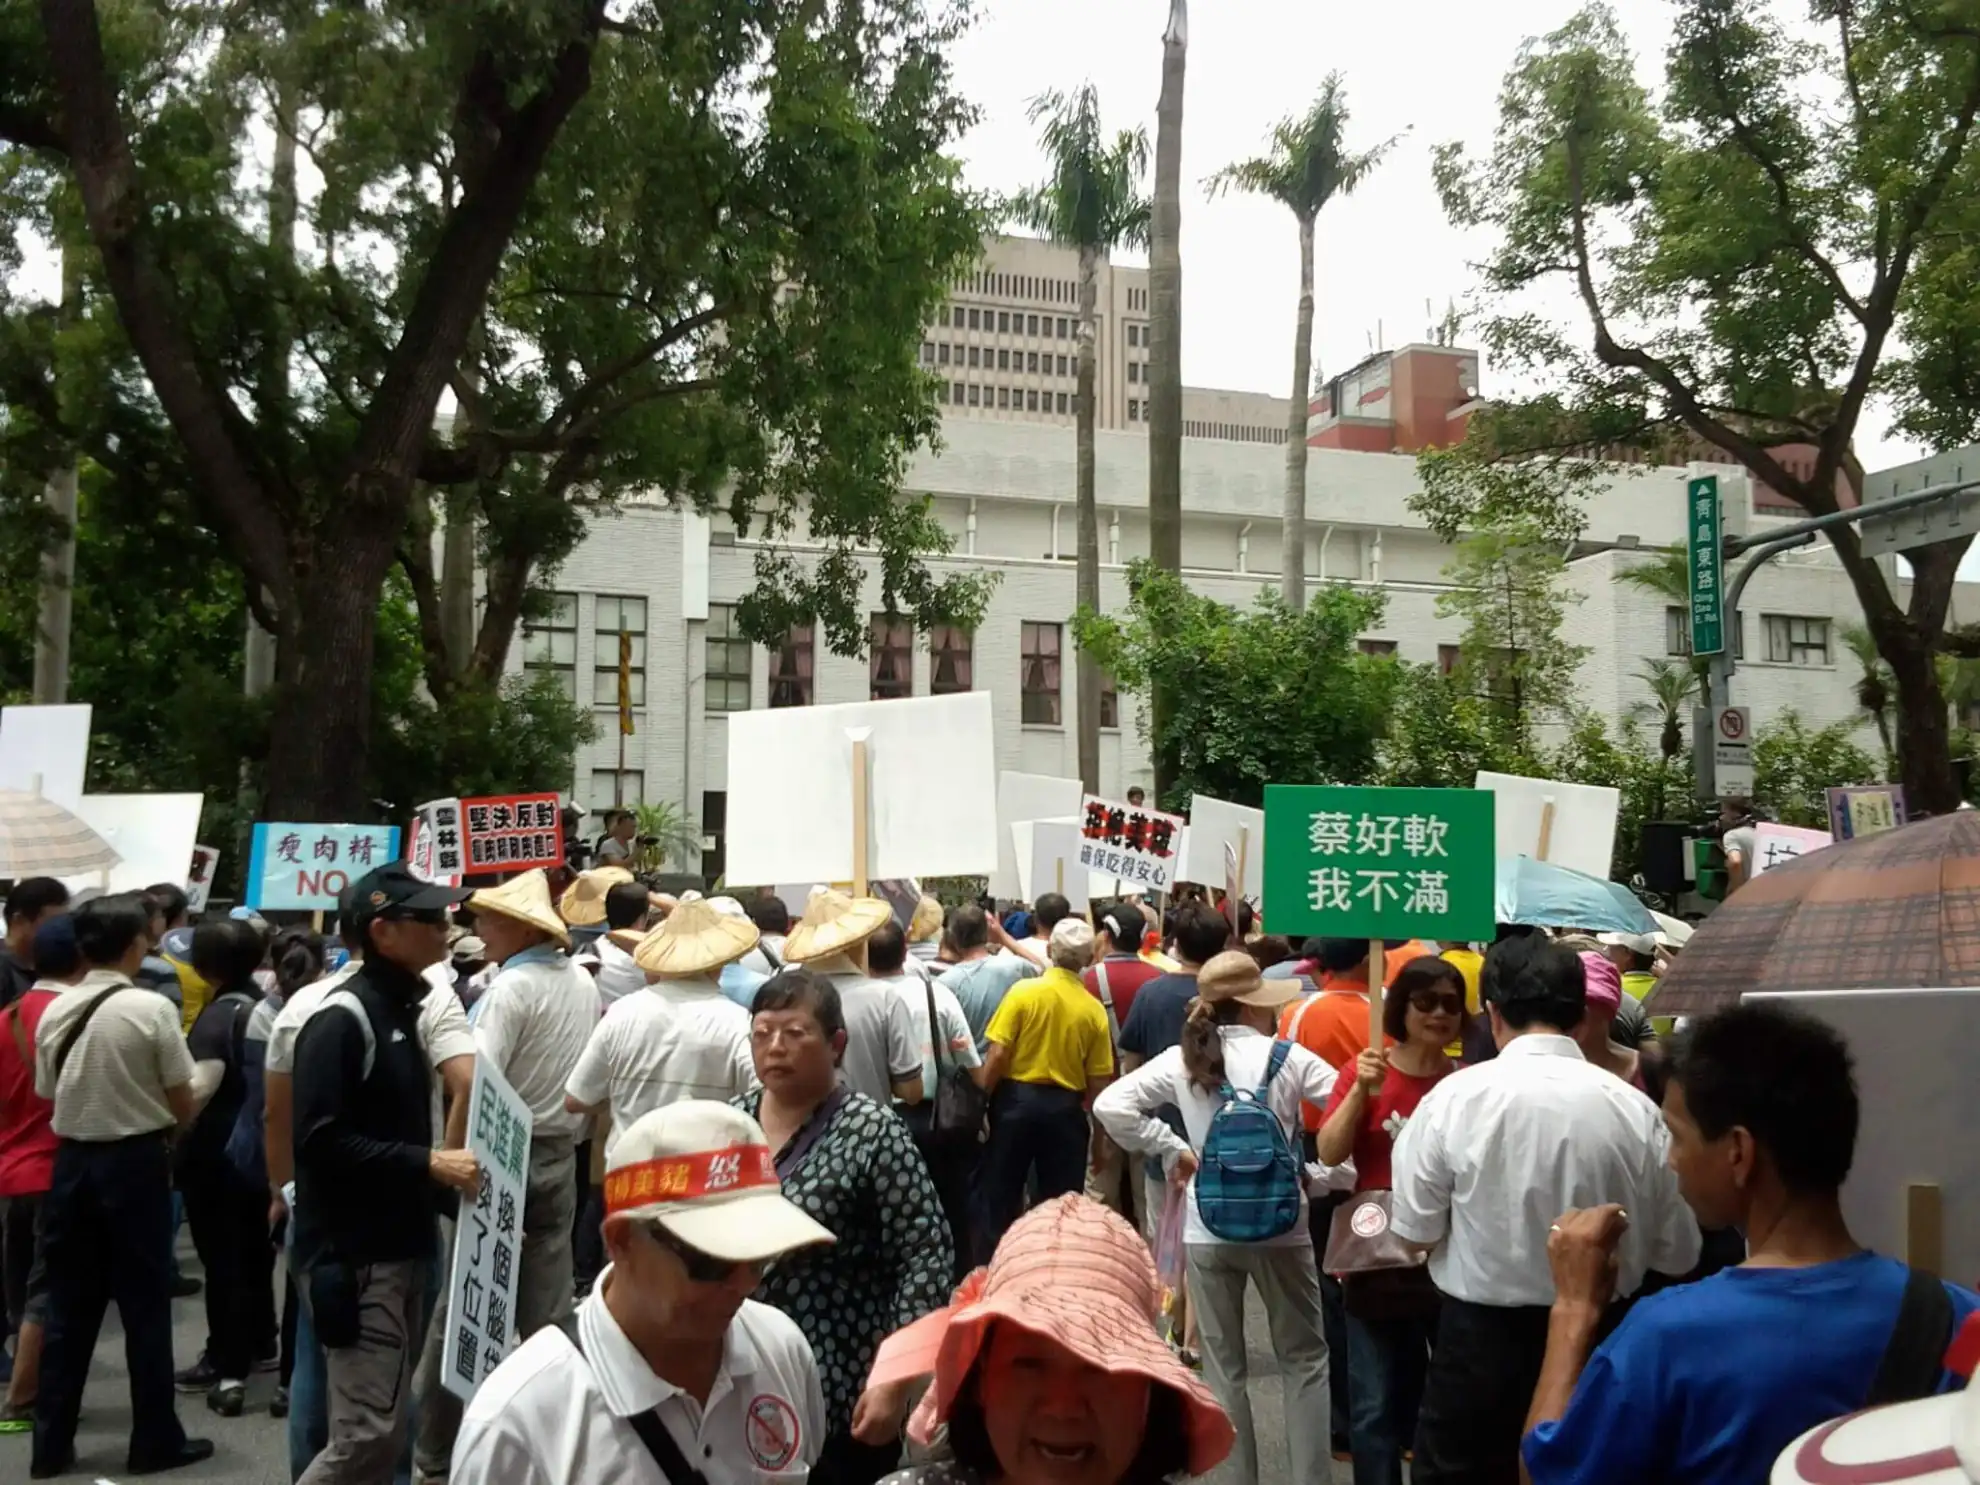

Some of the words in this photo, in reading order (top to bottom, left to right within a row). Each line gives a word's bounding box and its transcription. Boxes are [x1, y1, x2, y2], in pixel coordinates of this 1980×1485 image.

[1696, 498, 1714, 590] 青島東路
[436, 806, 460, 869] 雲林縣
[469, 802, 555, 833] 堅決反對
[1308, 811, 1449, 857] 蔡好軟
[276, 832, 378, 866] 瘦肉精
[1080, 844, 1166, 886] 確保吃得安心
[296, 870, 348, 897] NO
[1307, 866, 1449, 914] 我不滿
[476, 1076, 528, 1188] 民進黨
